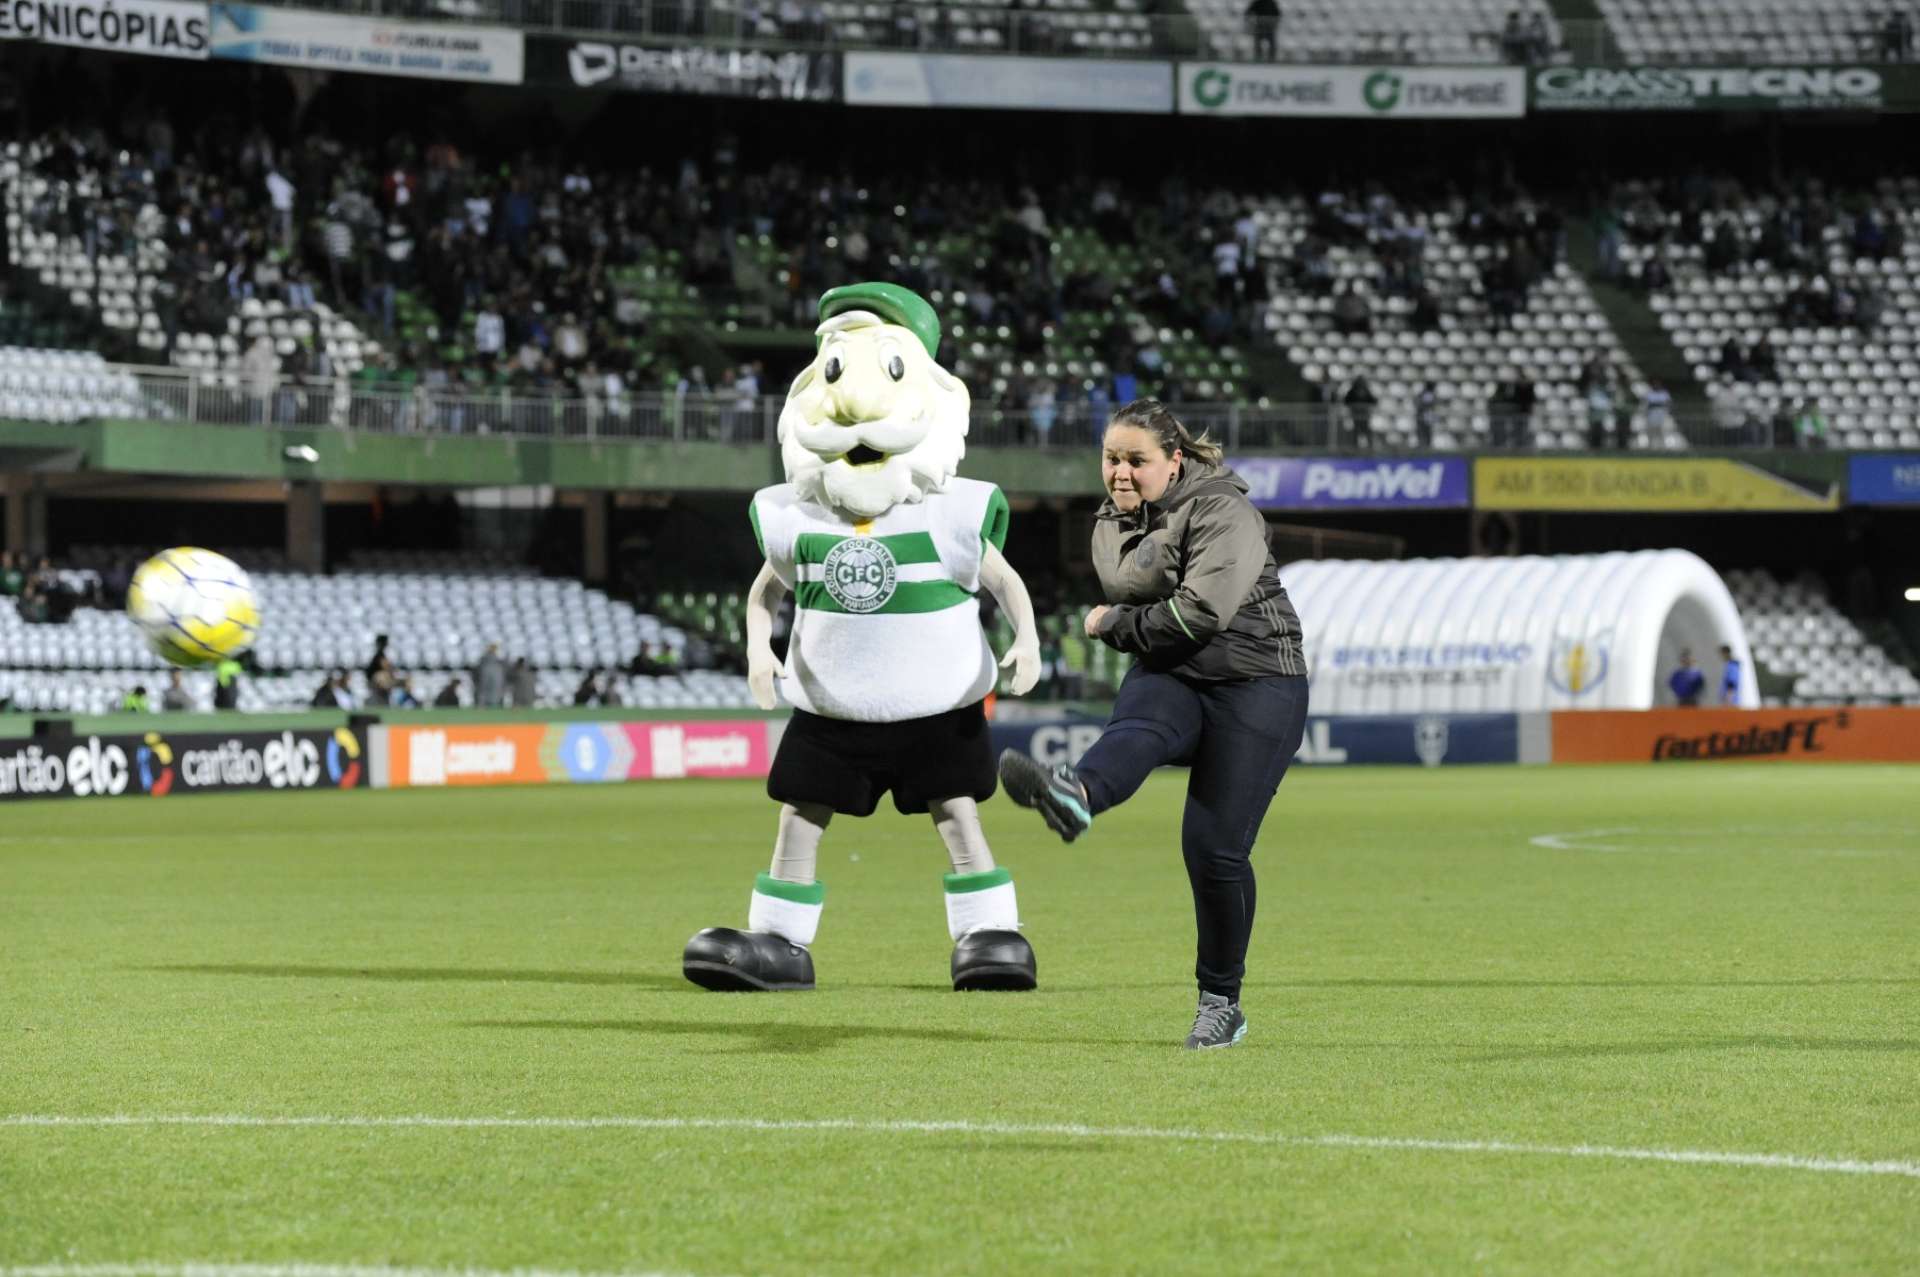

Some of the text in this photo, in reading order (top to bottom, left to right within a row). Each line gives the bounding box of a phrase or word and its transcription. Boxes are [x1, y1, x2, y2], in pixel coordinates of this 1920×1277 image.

[1303, 463, 1445, 500] PanVel
[837, 564, 882, 583] CFC
[181, 739, 263, 787] cartão
